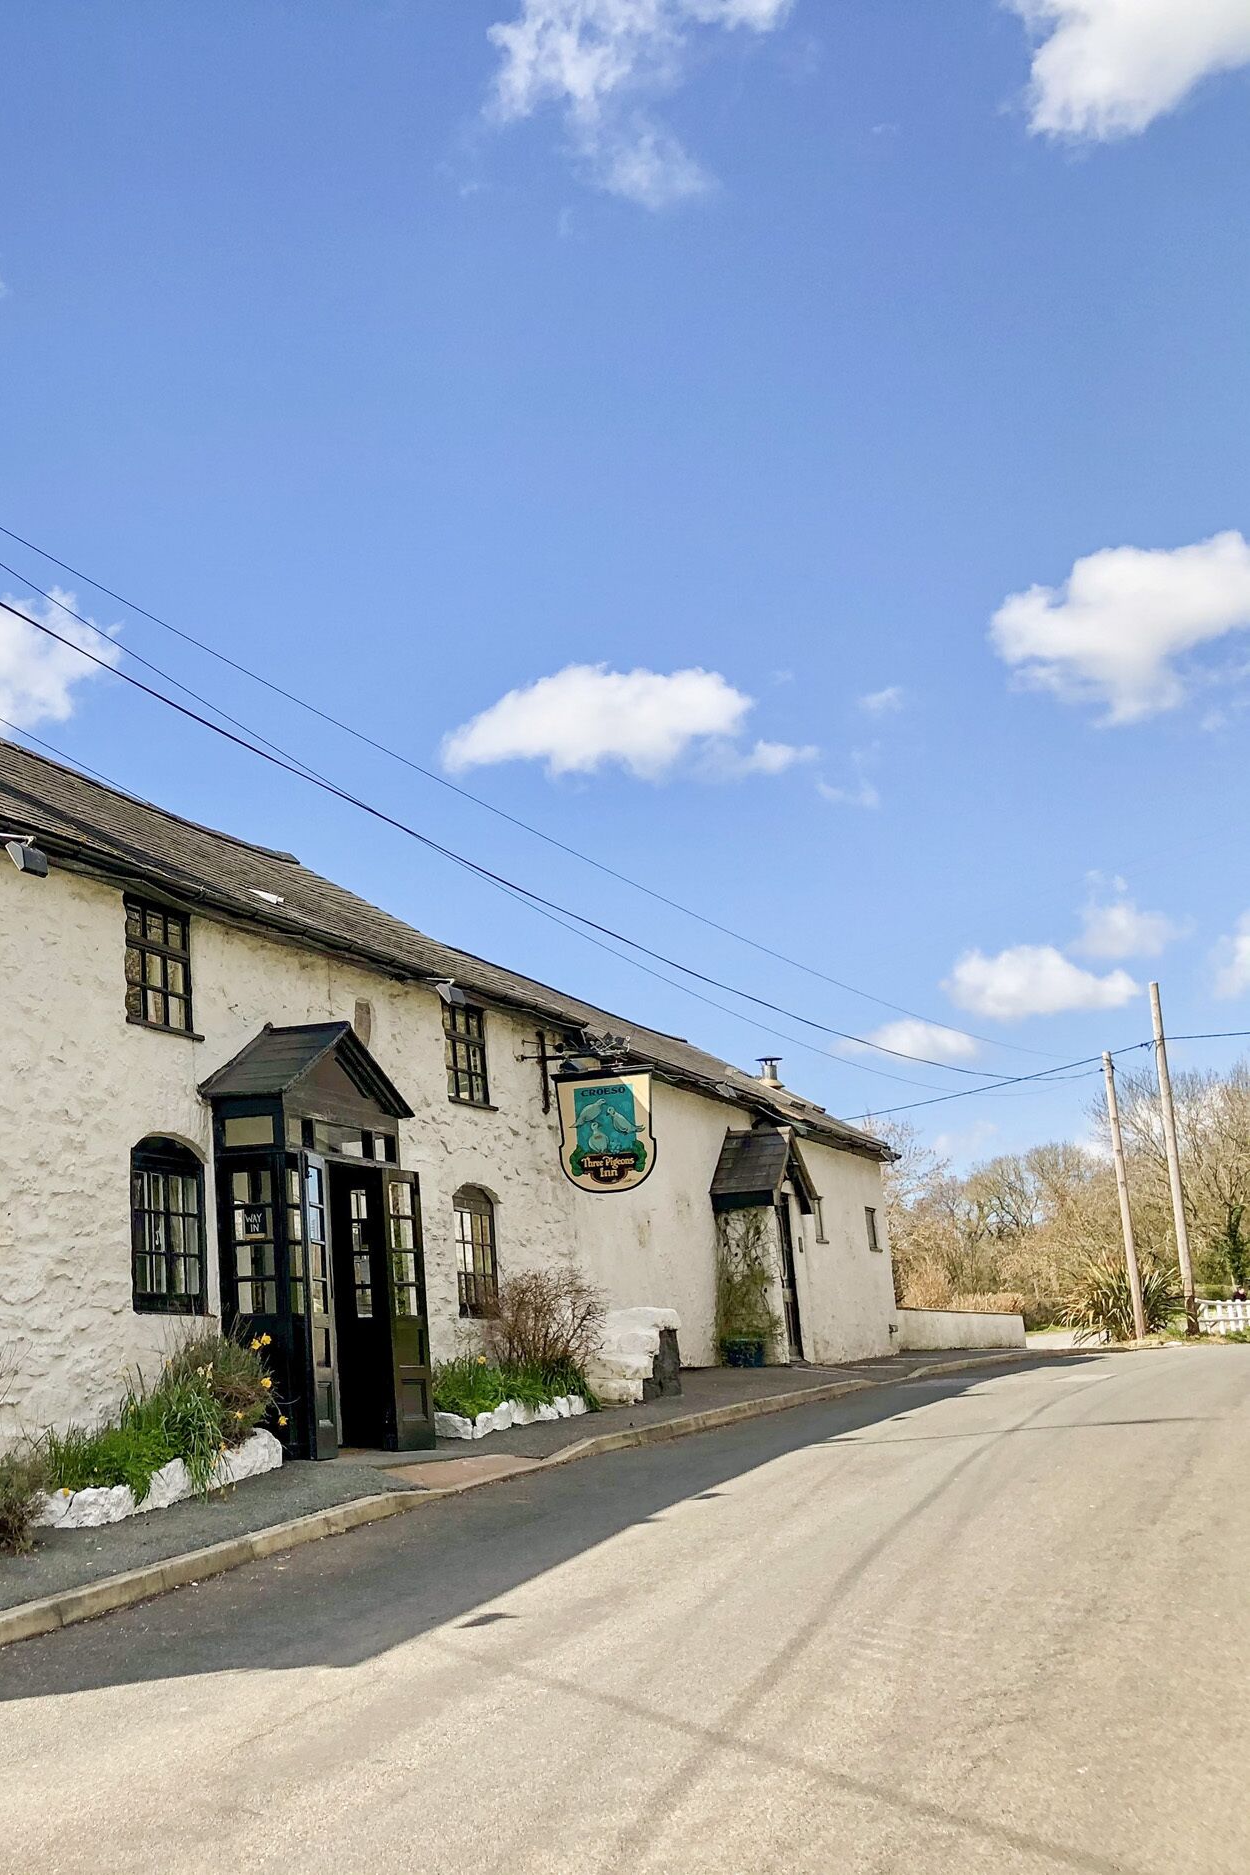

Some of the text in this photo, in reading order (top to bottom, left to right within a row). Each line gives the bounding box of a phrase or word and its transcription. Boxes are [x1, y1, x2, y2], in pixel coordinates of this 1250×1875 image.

[581, 1086, 626, 1097] CROESO
[581, 1155, 635, 1169] Three Pigeons
[600, 1168, 618, 1177] Inn
[244, 1213, 262, 1223] WAY
[250, 1223, 260, 1232] IN
